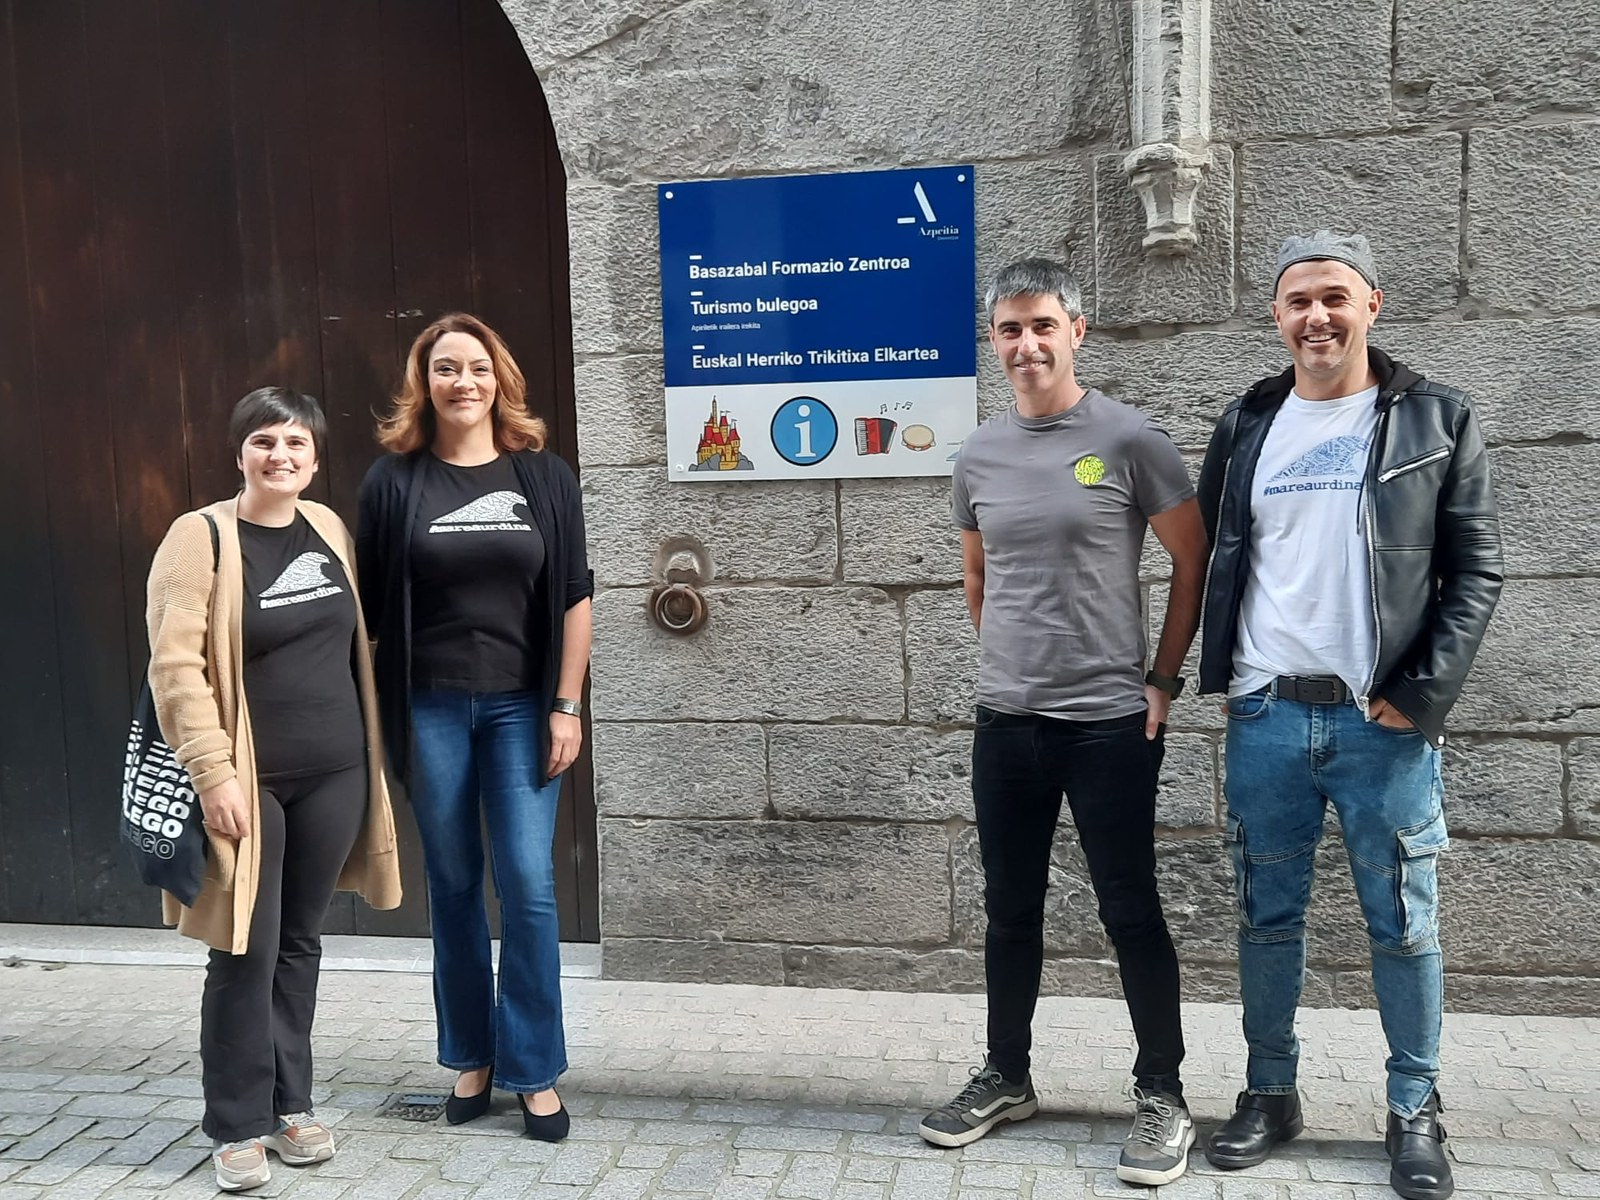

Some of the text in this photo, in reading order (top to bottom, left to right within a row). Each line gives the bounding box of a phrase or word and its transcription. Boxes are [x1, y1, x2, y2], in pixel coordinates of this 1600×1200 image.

[919, 225, 959, 238] Azpeitia
[689, 256, 910, 280] Basazabal Formazio Zentroa
[691, 297, 818, 315] Turismo bulegoa
[692, 347, 939, 369] Euskal Herriko Trikitixa Elkartea
[1263, 480, 1362, 496] #mareaurdina
